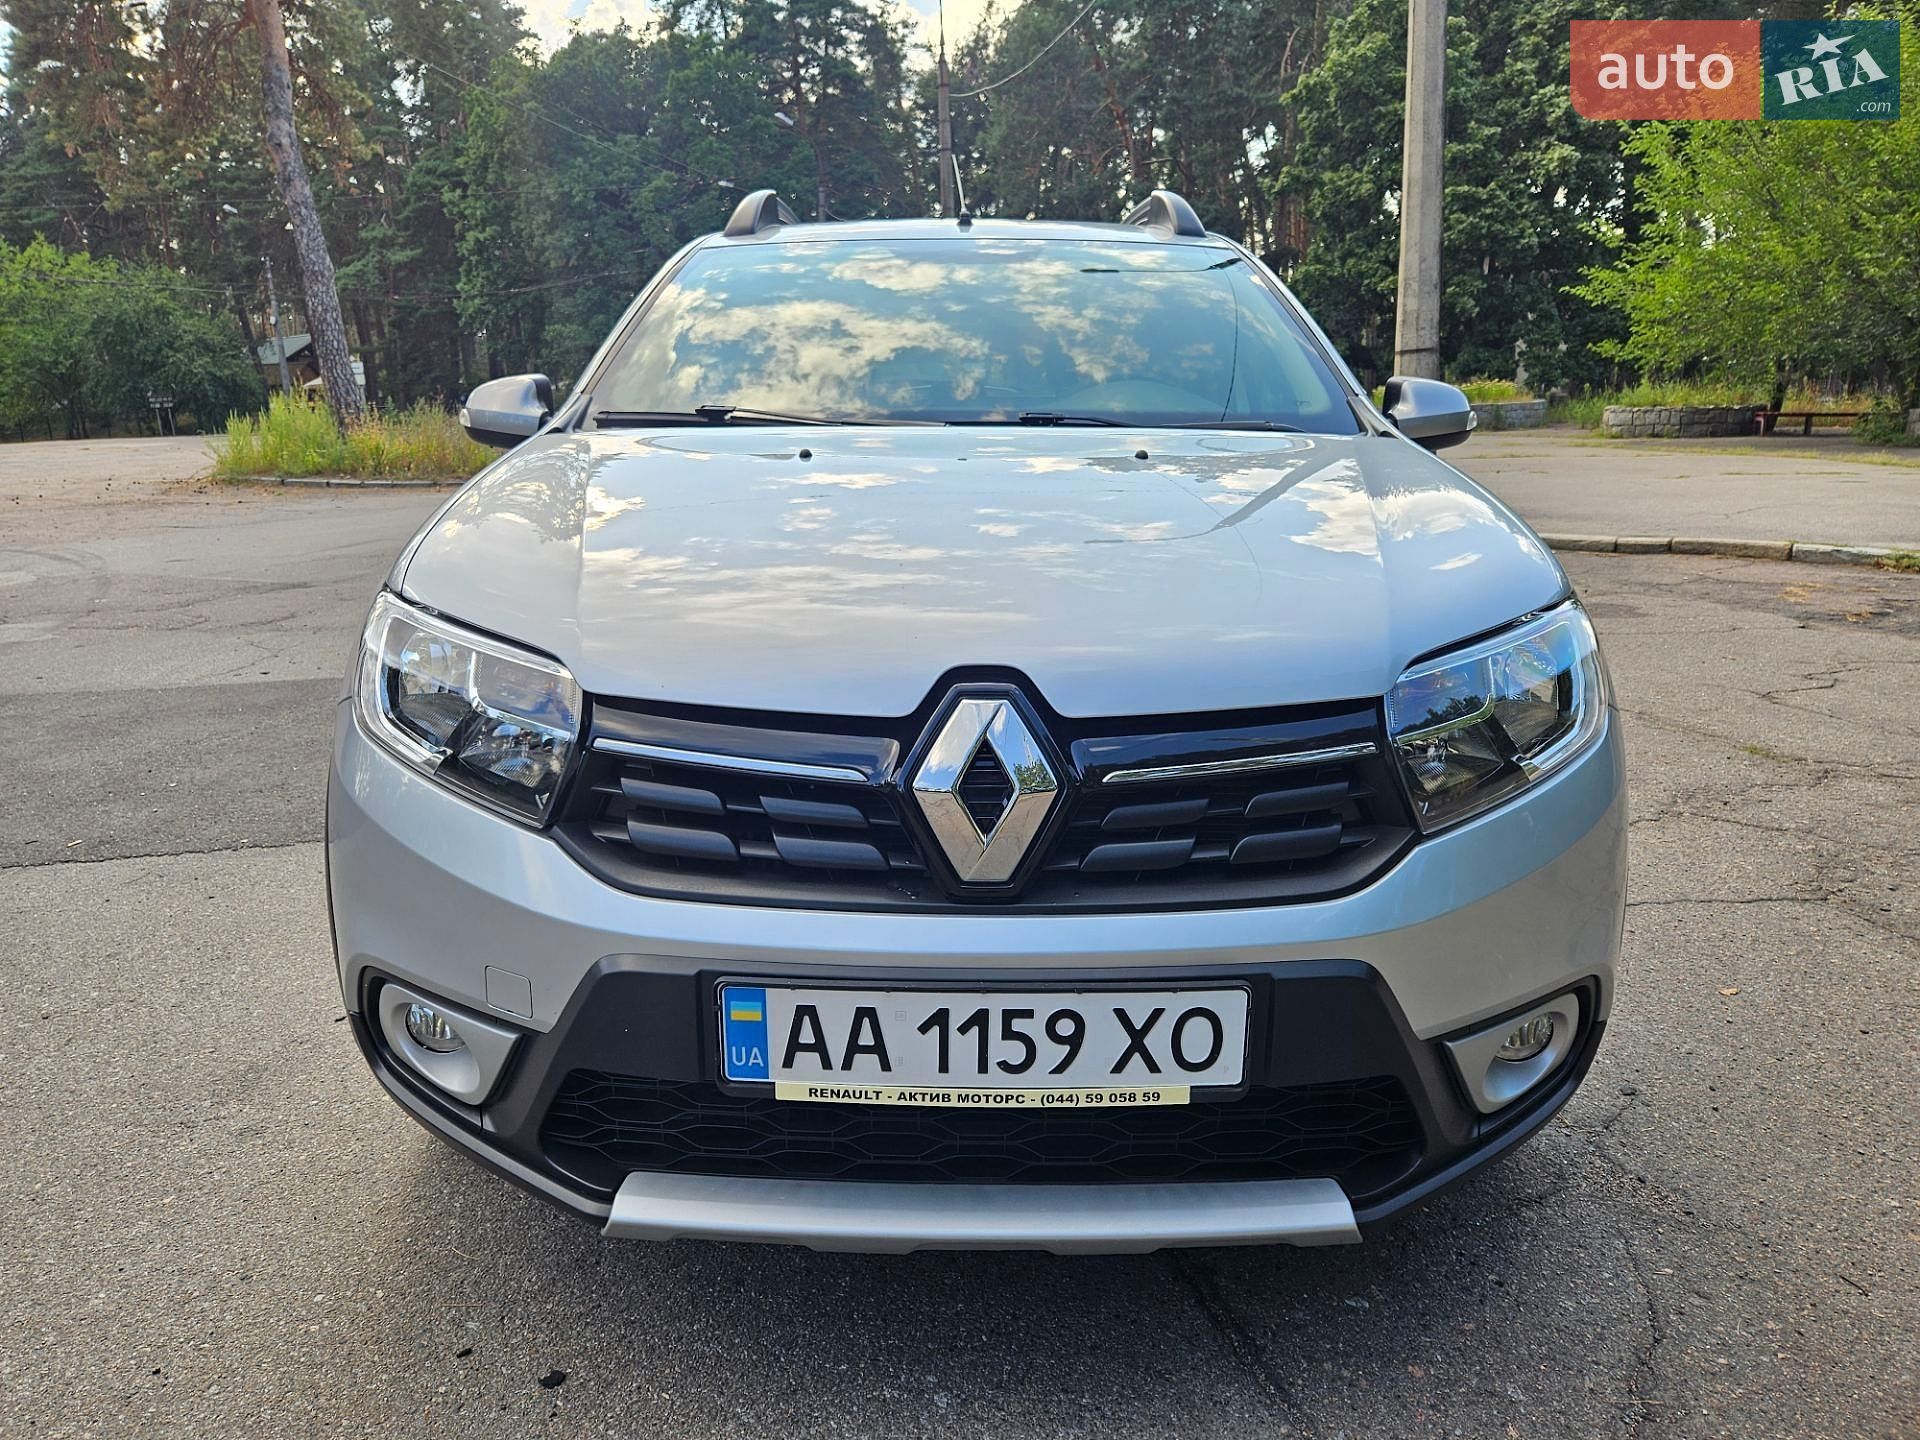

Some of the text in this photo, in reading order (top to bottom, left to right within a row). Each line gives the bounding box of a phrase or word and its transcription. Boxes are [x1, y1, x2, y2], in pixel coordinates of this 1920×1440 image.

[781, 1003, 1224, 1075] AA 1159 XO
[731, 1045, 764, 1067] UA
[808, 1087, 883, 1101] RENAULT
[897, 1091, 952, 1103] АКТИВ
[957, 1093, 1026, 1104] МОТОРС
[1041, 1093, 1080, 1106] (044)
[1085, 1093, 1104, 1104] 59
[1109, 1092, 1137, 1103] 058
[1142, 1091, 1161, 1102] 59
